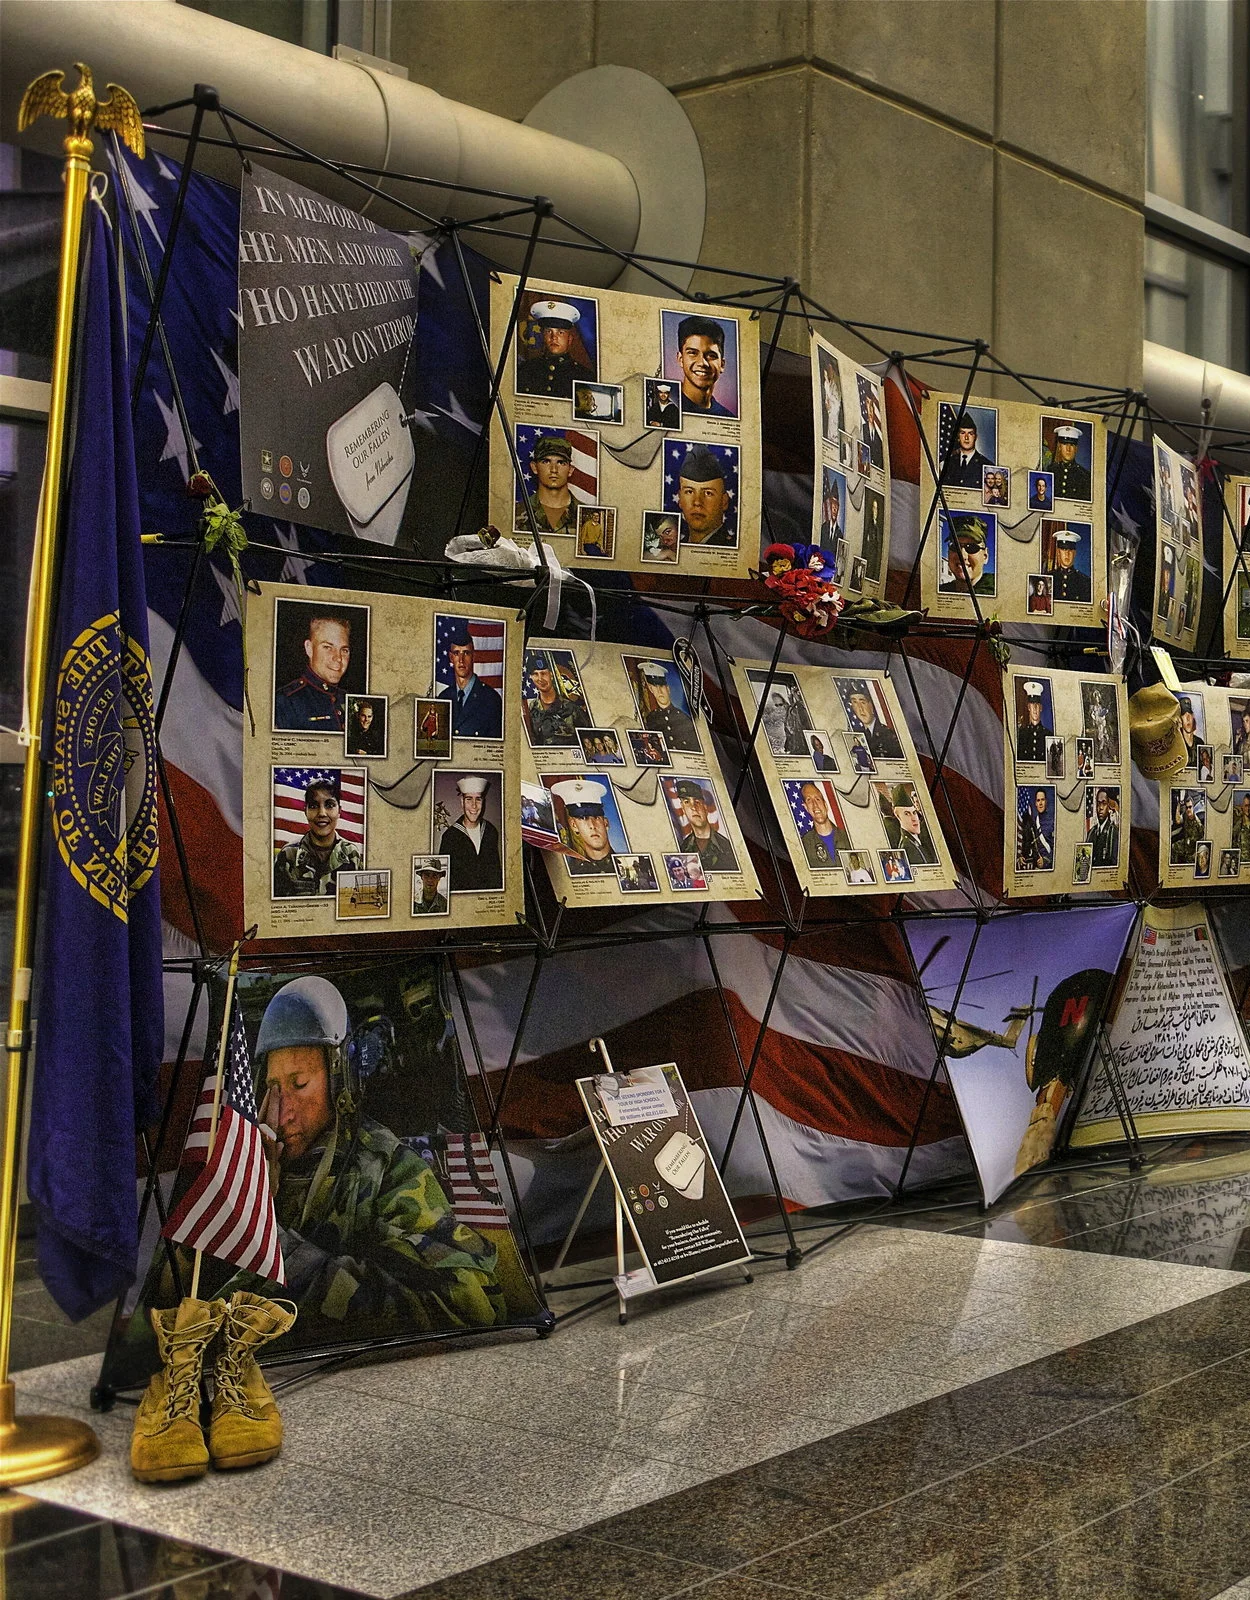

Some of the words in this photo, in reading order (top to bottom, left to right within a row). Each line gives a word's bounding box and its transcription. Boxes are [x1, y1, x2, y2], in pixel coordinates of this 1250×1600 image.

[253, 185, 286, 216] IN
[285, 193, 361, 231] MEMORY
[239, 230, 283, 263] HE
[282, 234, 335, 264] MEN
[336, 241, 366, 266] AND
[363, 244, 404, 267] WOMEN
[298, 283, 359, 319] HAVE
[354, 281, 388, 308] DIED
[384, 280, 400, 303] IN
[396, 279, 416, 301] THE
[292, 337, 355, 388] WAR
[352, 328, 379, 364] ON
[374, 314, 414, 353] TERROR
[344, 409, 390, 458] REMEMBERING
[352, 450, 369, 469] OUR
[368, 427, 391, 454] FALLEN
[1059, 995, 1089, 1027] N
[629, 1126, 658, 1153] WAR
[665, 1144, 688, 1172] REMEMBERING
